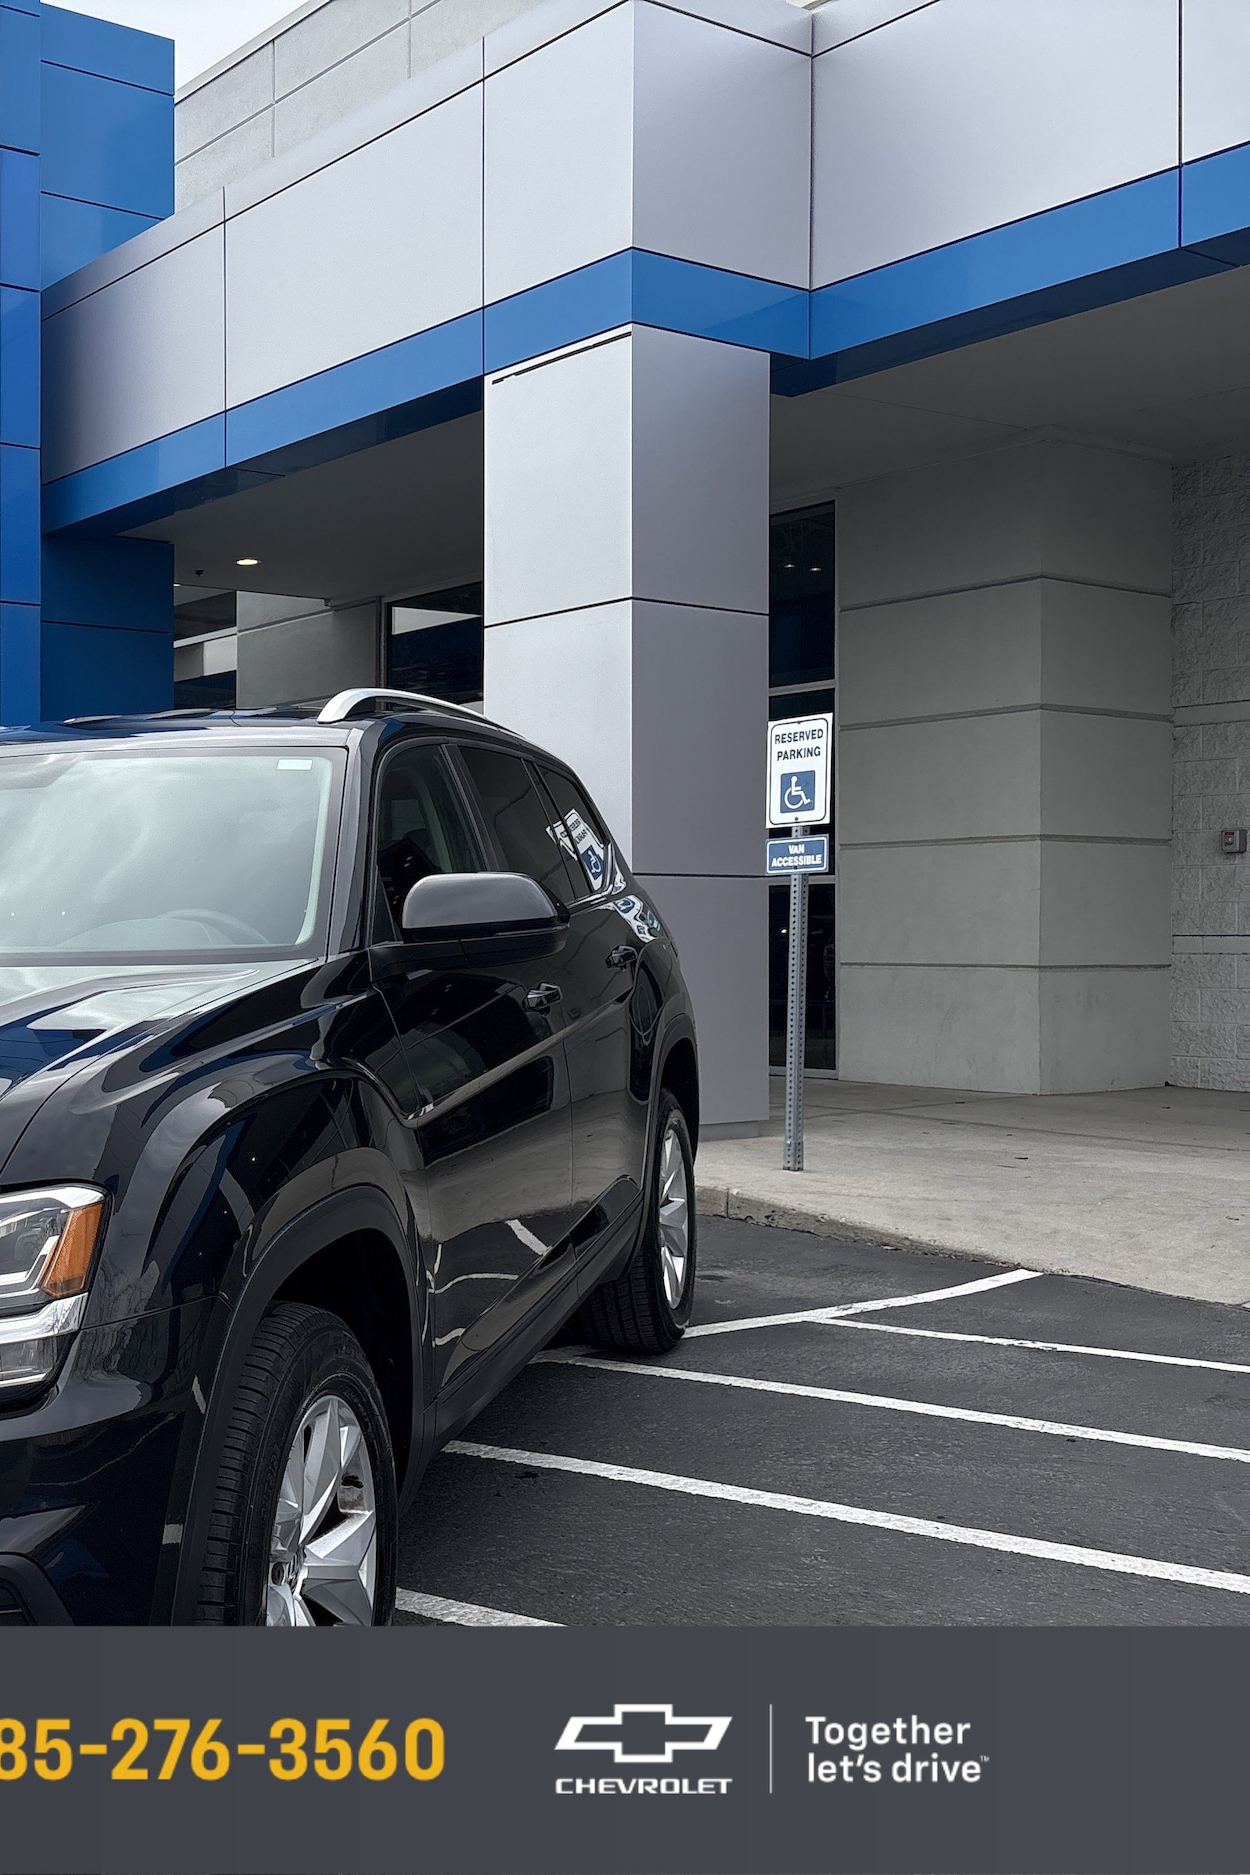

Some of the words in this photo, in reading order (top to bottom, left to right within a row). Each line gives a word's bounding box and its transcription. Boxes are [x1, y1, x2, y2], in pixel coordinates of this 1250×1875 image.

[774, 728, 823, 744] RESERVED
[777, 746, 821, 761] PARKING
[788, 844, 805, 854] VAN
[771, 854, 822, 867] ACCESSIBLE
